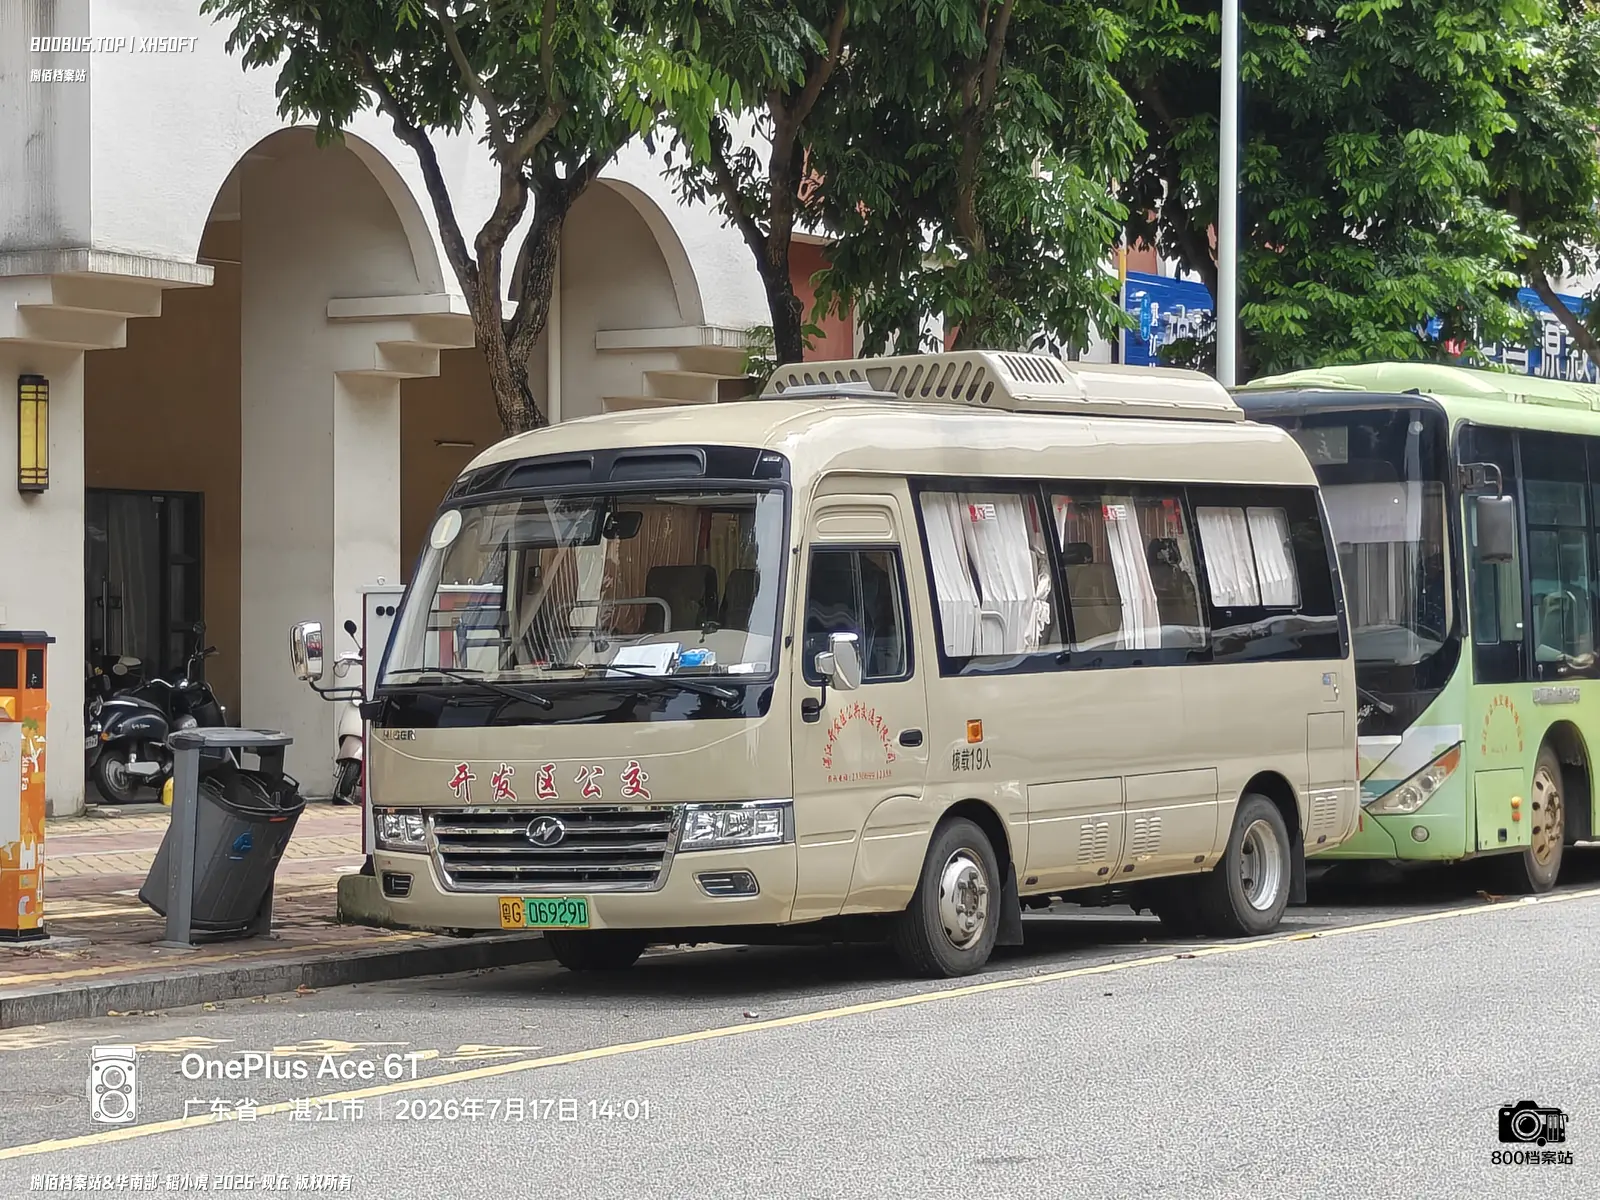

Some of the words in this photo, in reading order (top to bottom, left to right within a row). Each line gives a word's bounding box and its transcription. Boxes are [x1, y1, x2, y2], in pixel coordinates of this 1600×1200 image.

[951, 747, 992, 771] 核载19人
[449, 760, 651, 803] 开发区公交
